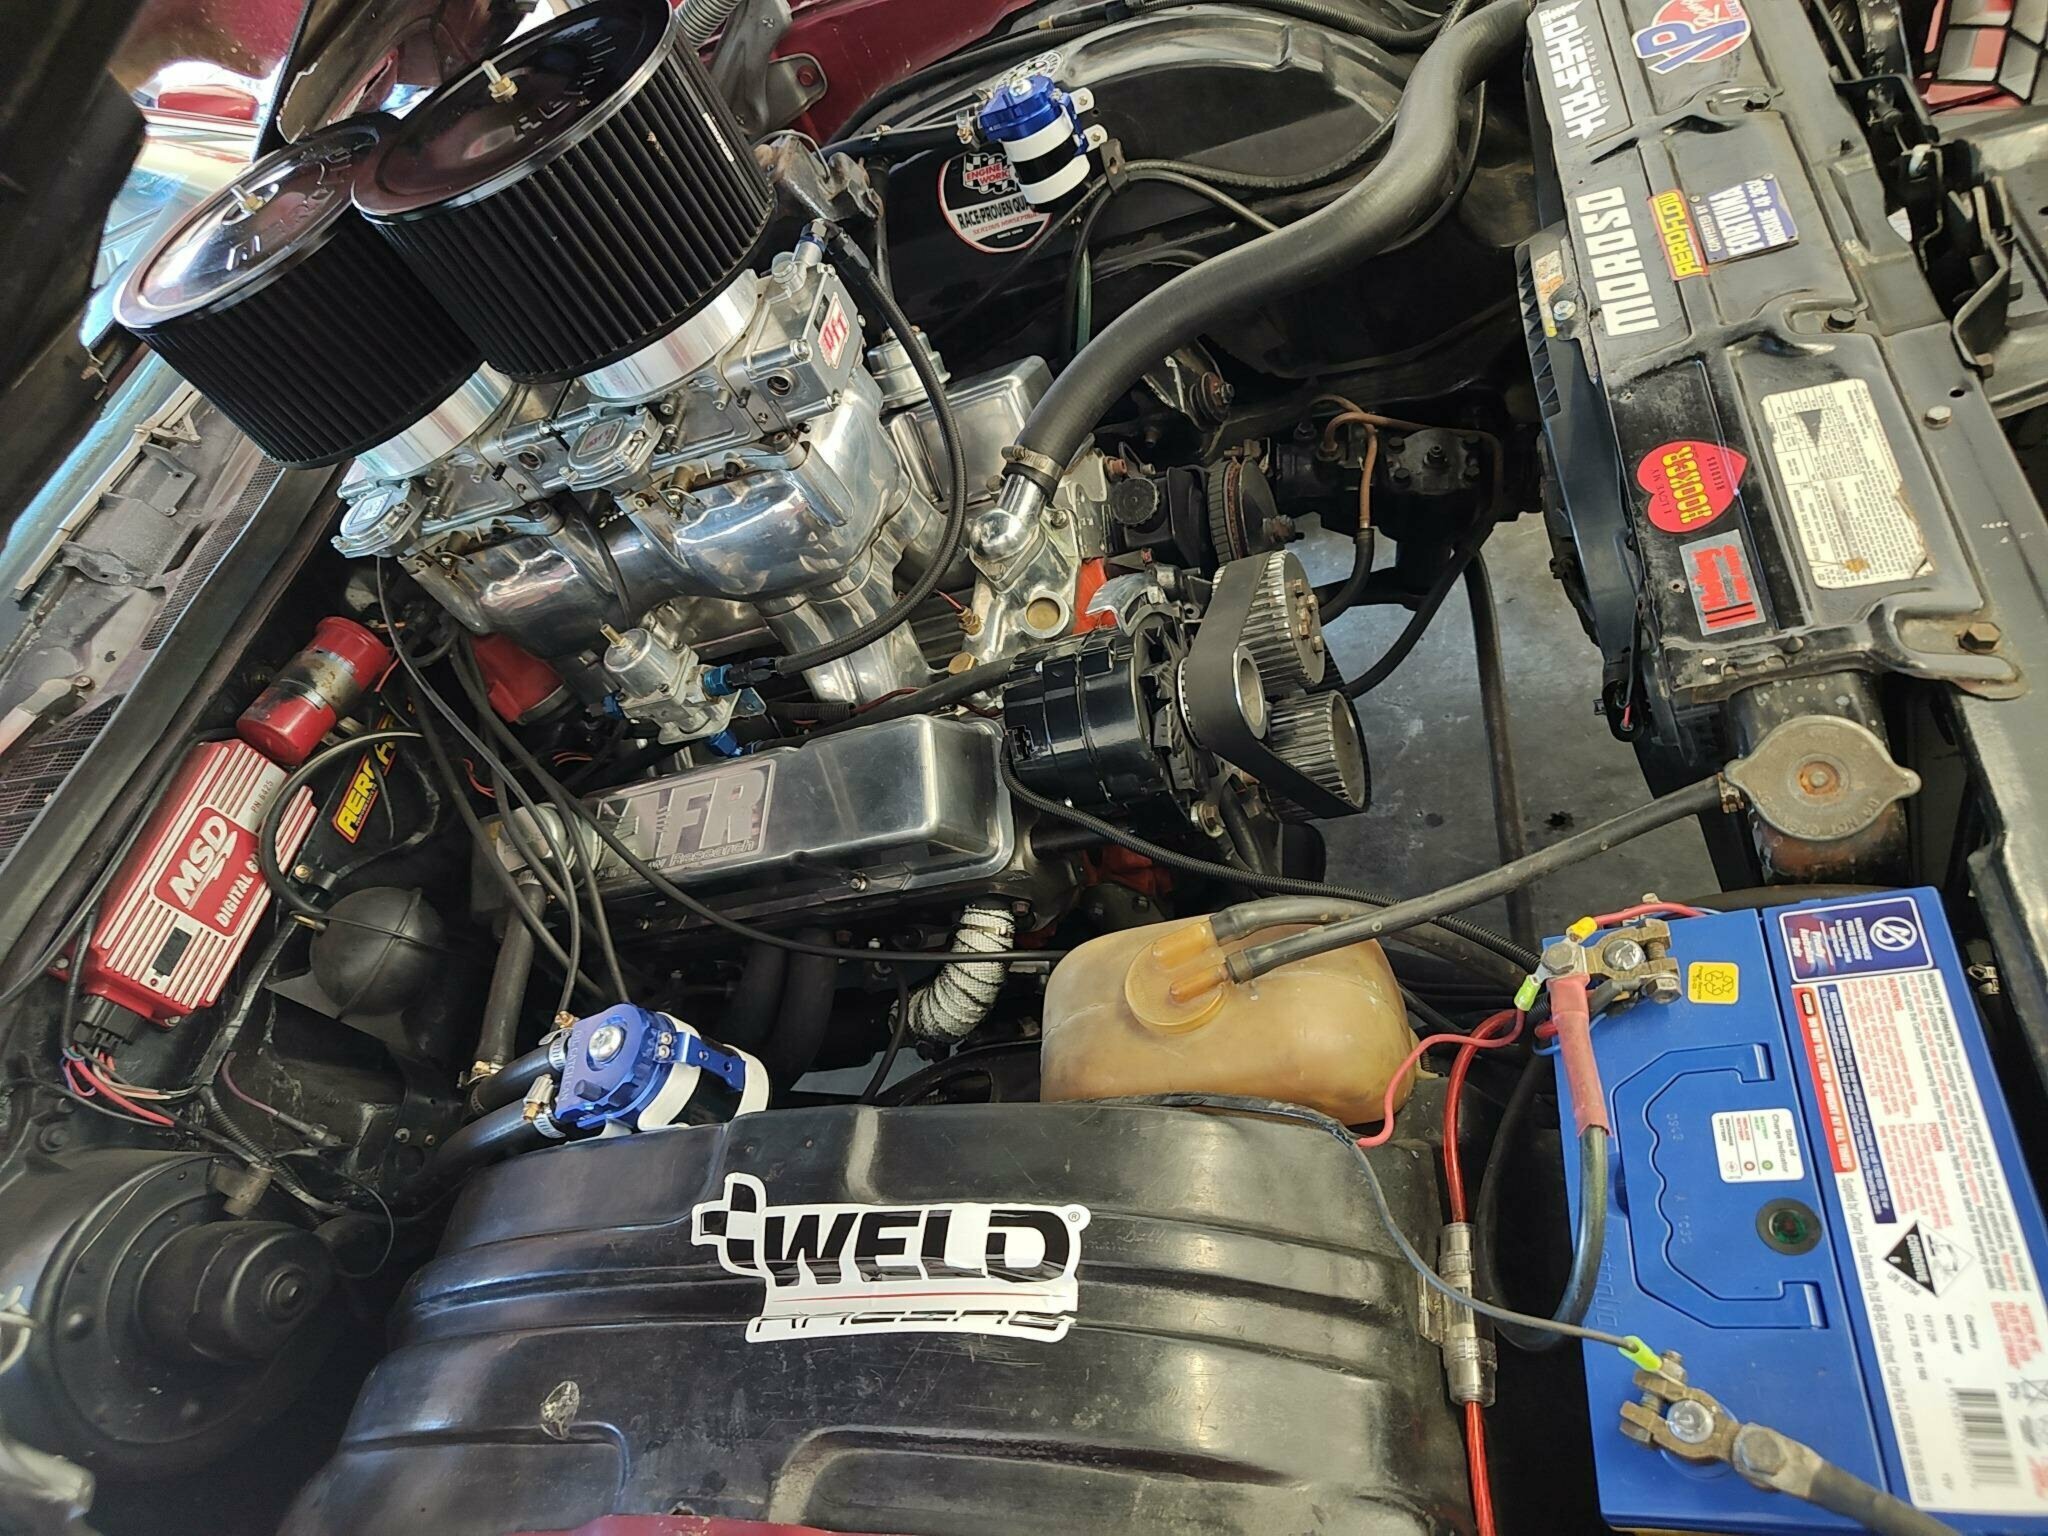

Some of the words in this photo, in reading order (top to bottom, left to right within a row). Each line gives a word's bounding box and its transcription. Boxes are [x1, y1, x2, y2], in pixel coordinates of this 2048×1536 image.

[1583, 33, 1602, 76] STREET
[1634, 19, 1748, 73] VP
[1596, 80, 1610, 104] PRO
[965, 162, 1001, 182] ENGINE
[956, 201, 1014, 230] RACE-PROVEN
[1707, 184, 1765, 257] FORTUNA
[1576, 186, 1660, 336] MOROSO
[1662, 444, 1713, 525] HOOKER
[1706, 455, 1726, 491] HEADERS
[259, 780, 275, 802] 6425
[168, 815, 232, 907] MSD
[214, 873, 256, 929] DIGITAL
[1885, 976, 1905, 1011] WARNING
[1770, 1113, 1783, 1139] Charge
[1784, 1128, 1794, 1147] State
[1926, 1121, 1945, 1152] POISON
[1776, 1140, 1789, 1173] Indicator
[1788, 1148, 1796, 1156] of
[763, 1208, 1072, 1287] WELD
[1904, 1233, 1930, 1283] CORROSIVE
[1962, 1313, 1981, 1350] Century
